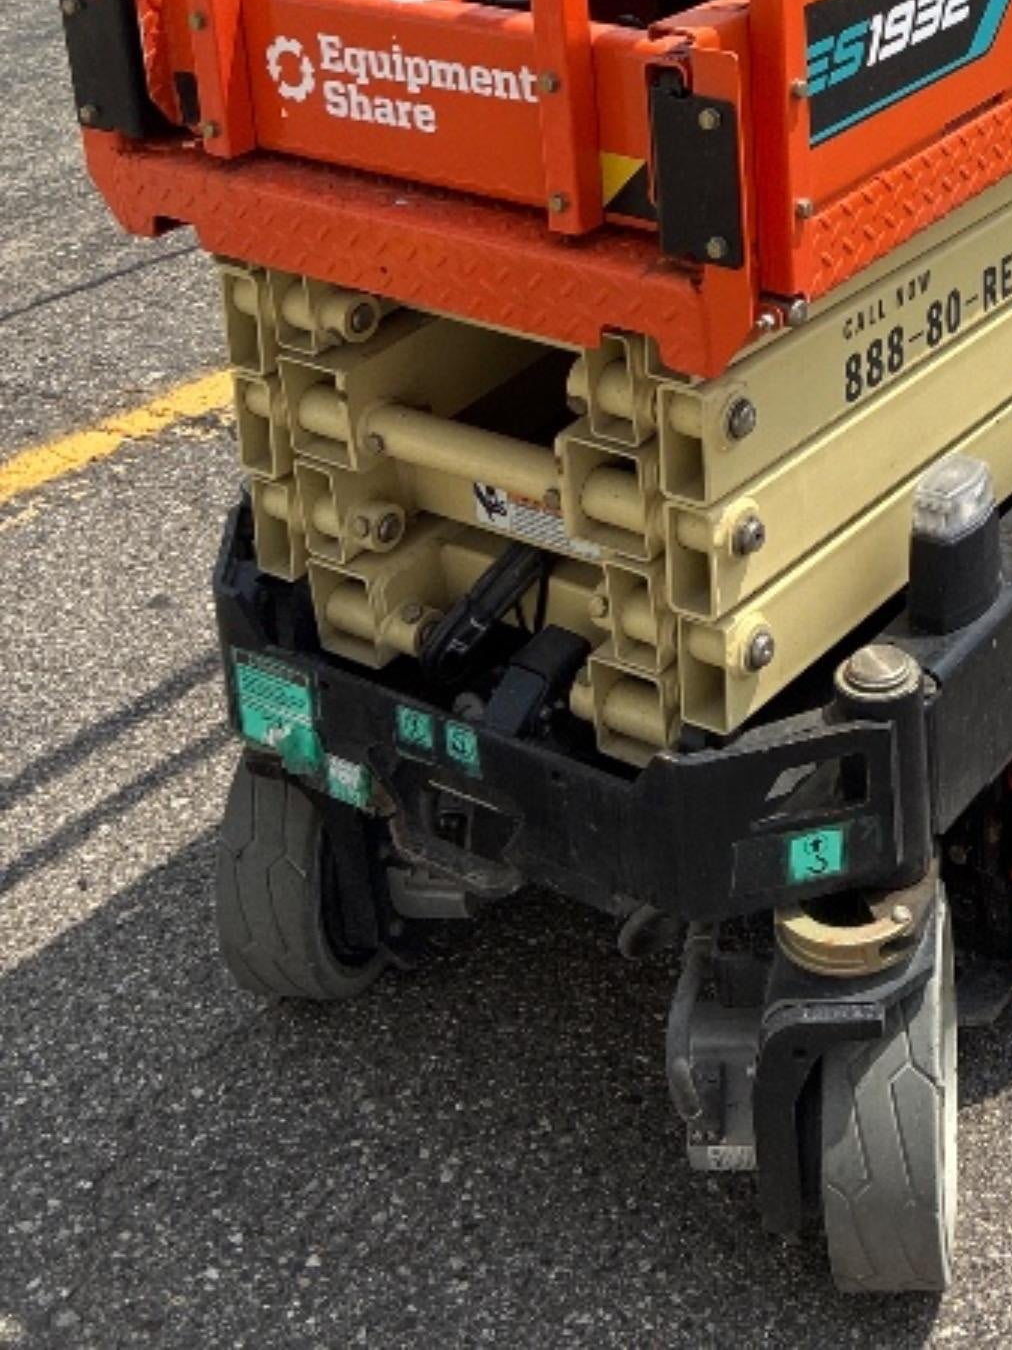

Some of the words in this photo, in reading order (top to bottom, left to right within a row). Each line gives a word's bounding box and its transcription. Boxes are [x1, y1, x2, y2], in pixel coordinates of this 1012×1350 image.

[316, 32, 540, 103] Equipment
[322, 80, 437, 133] Share
[843, 299, 886, 340] CALL
[896, 269, 931, 306] NOW
